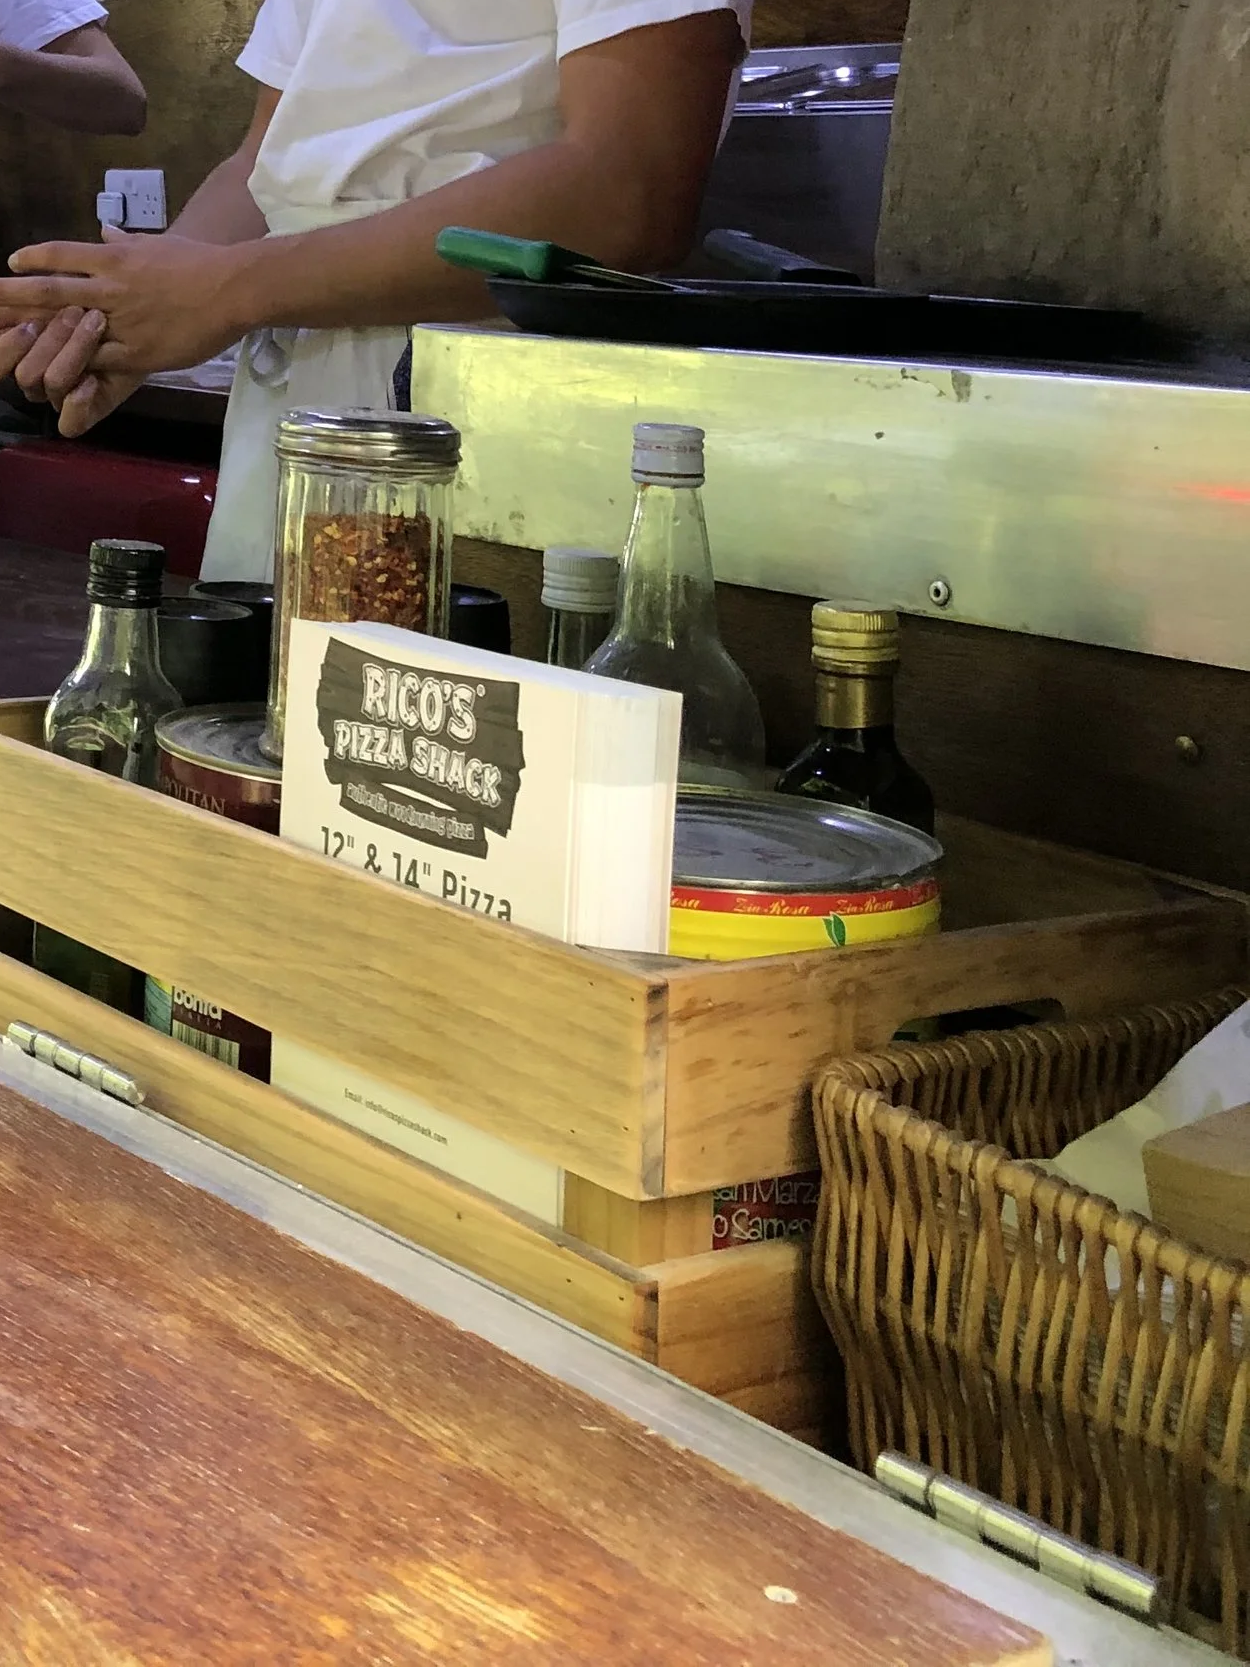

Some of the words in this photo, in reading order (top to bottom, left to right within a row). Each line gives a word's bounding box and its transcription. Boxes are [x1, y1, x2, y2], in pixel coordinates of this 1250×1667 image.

[361, 663, 477, 744] RICO'S
[333, 719, 408, 770] PIZZA
[410, 736, 501, 807] SHACK
[321, 826, 354, 858] 12"
[364, 843, 382, 874] &
[393, 852, 431, 889] 14"
[442, 869, 512, 922] Pizza
[733, 897, 759, 914] Zia
[764, 899, 811, 915] Rosa
